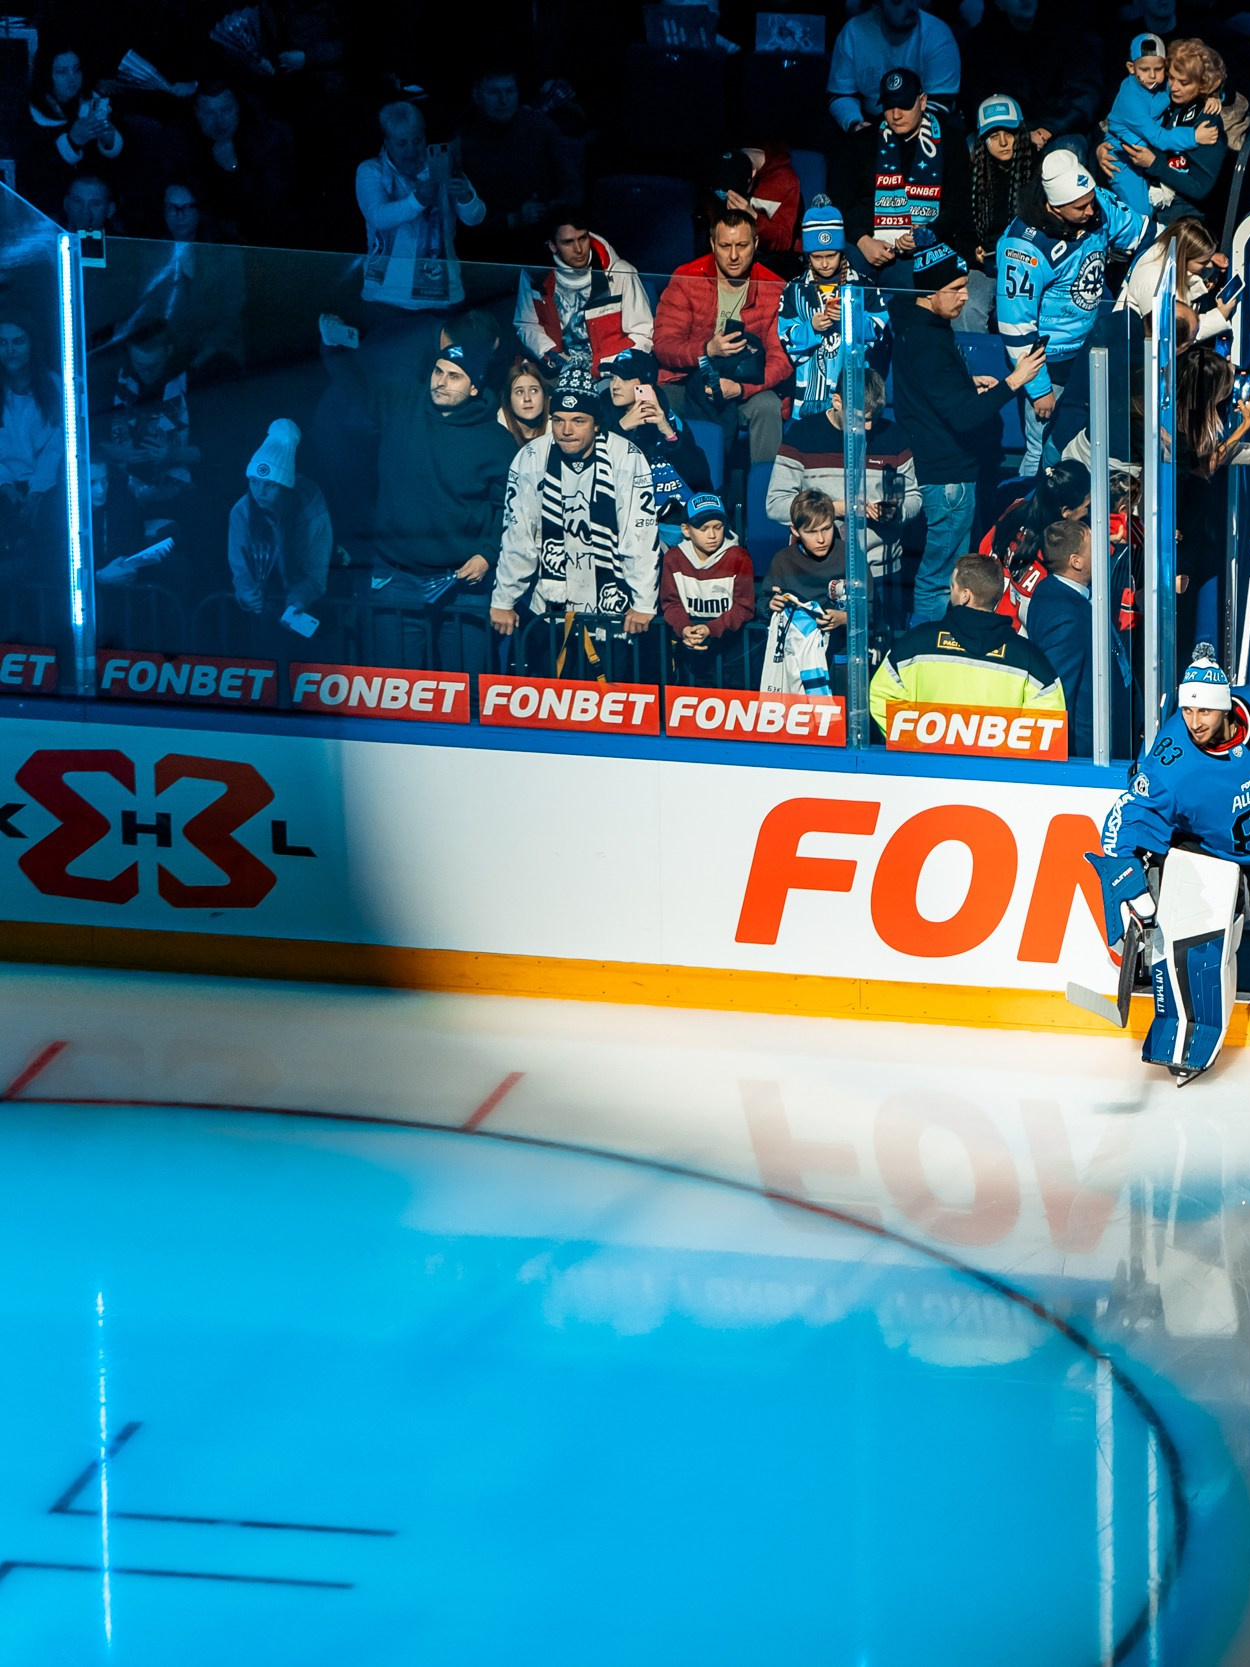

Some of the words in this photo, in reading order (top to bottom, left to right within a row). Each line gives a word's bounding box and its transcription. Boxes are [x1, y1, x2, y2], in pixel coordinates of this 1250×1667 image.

[905, 185, 940, 197] FONBET
[880, 215, 904, 225] 2023
[1005, 264, 1034, 300] 54
[656, 480, 683, 492] 2025
[101, 658, 274, 701] FONBET
[292, 671, 466, 714] FONBET
[483, 684, 655, 726] FONBET
[669, 696, 842, 738] FONBET
[889, 710, 1064, 752] FONBET
[1152, 736, 1184, 767] 83
